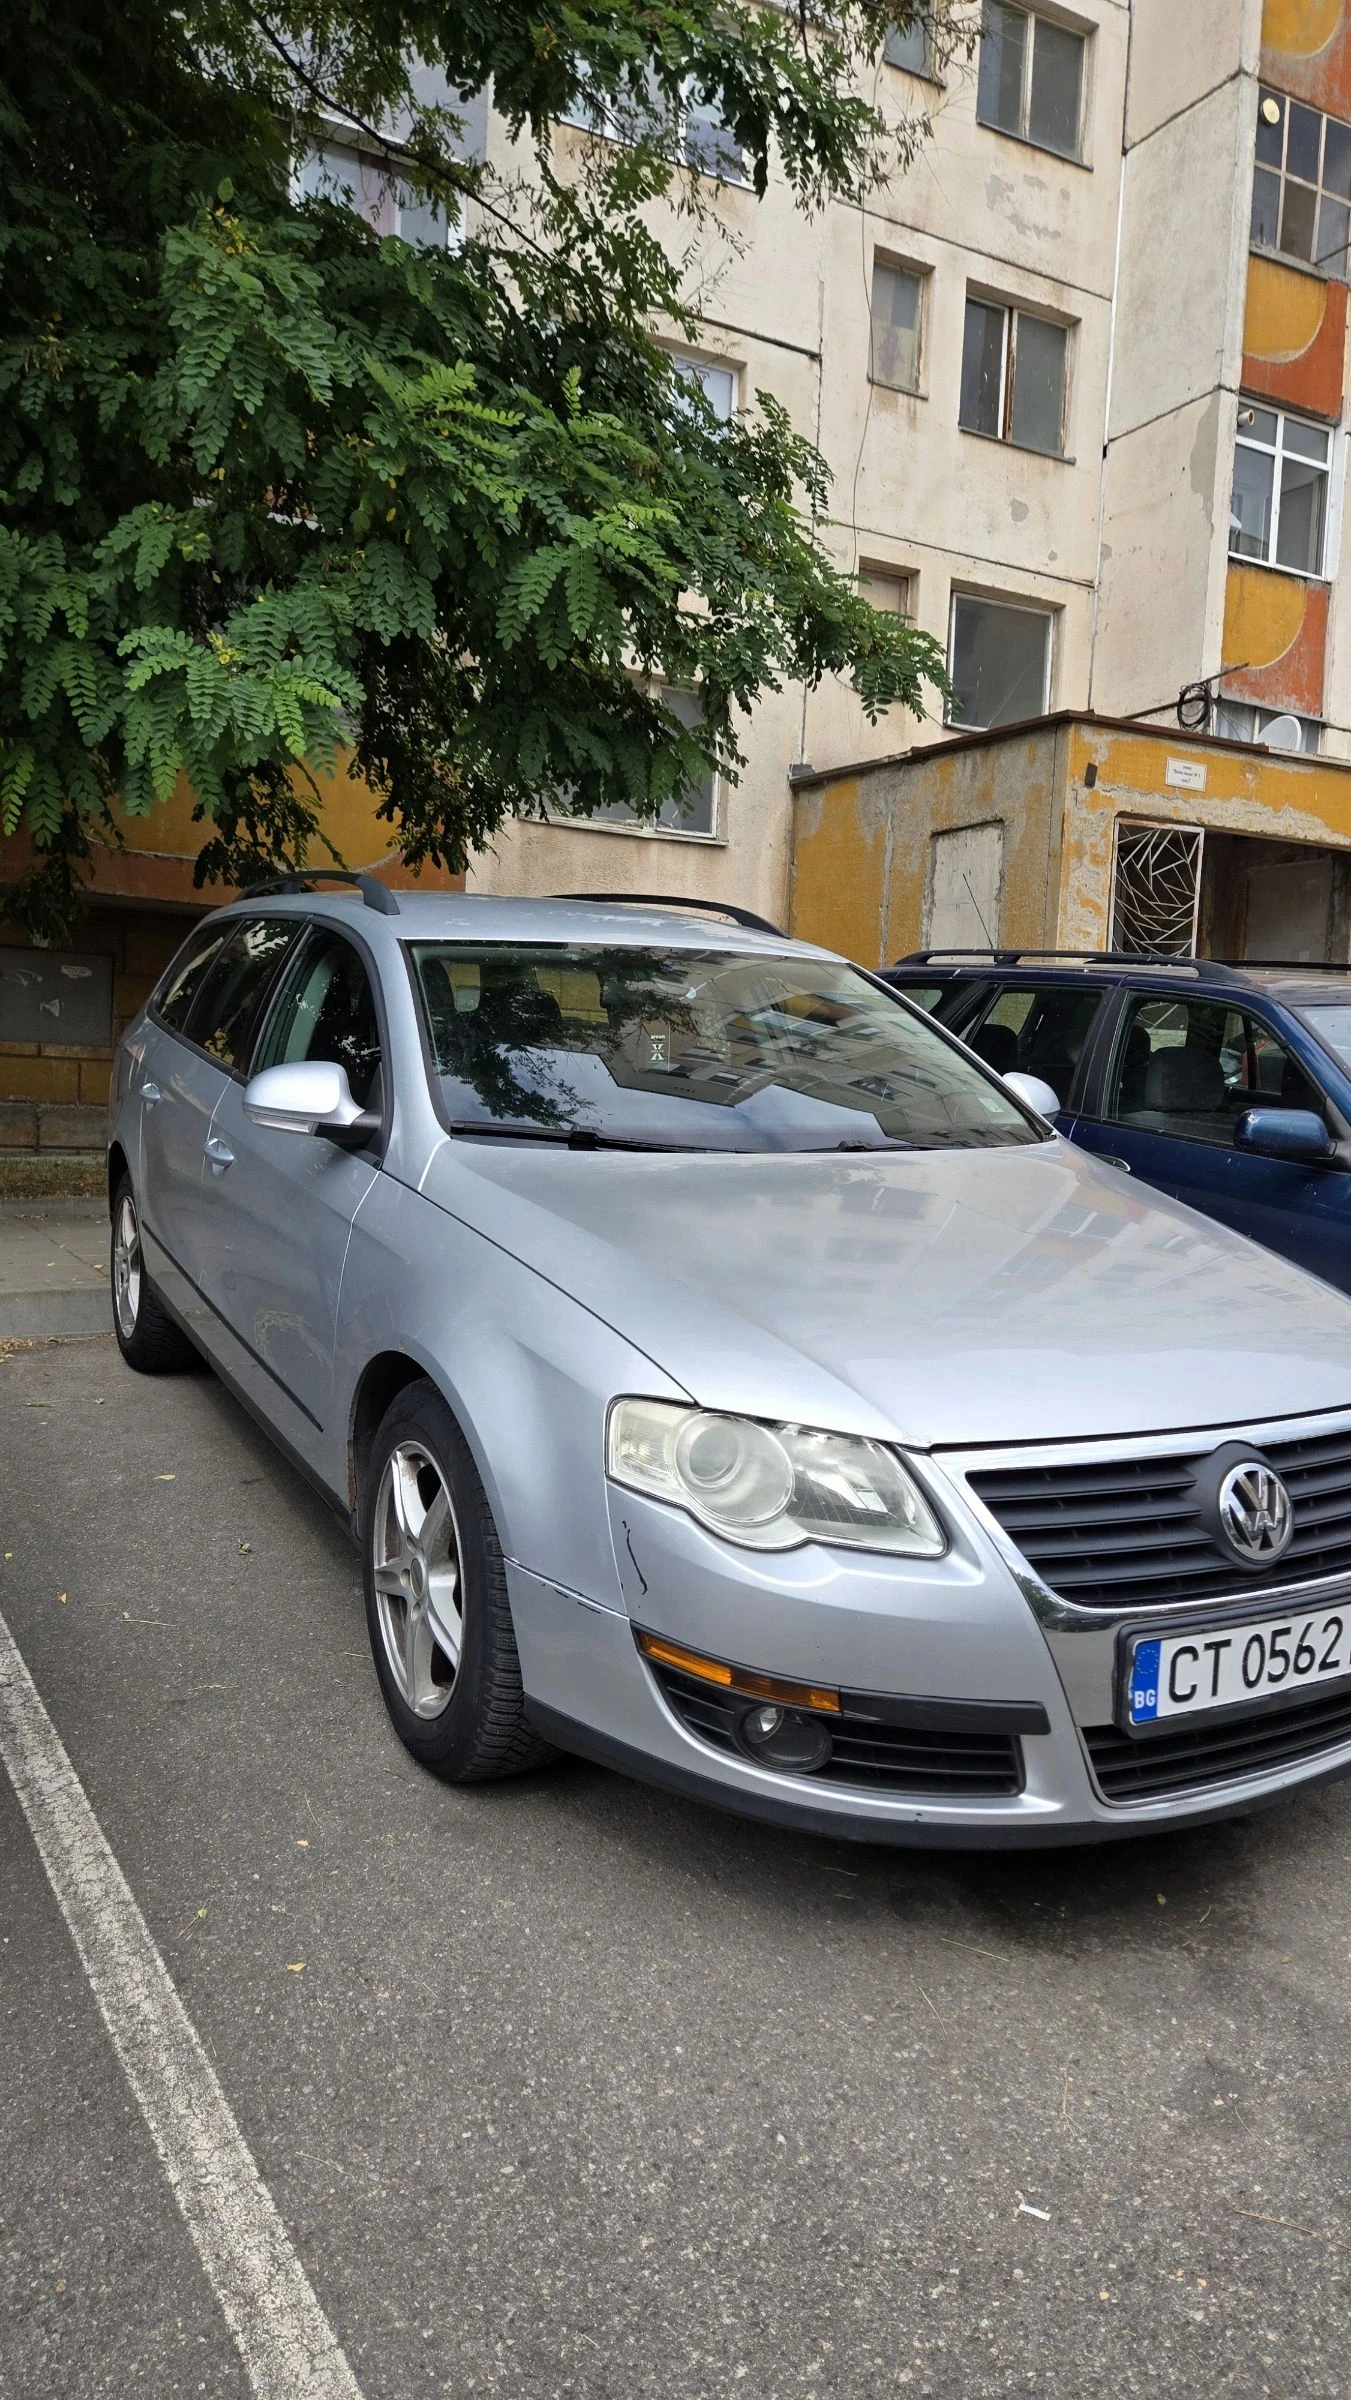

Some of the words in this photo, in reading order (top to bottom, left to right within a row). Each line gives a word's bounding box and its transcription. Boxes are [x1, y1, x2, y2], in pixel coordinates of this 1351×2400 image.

[1168, 1638, 1233, 1703] CT
[1241, 1616, 1343, 1689] 0562
[1133, 1689, 1156, 1709] BG
